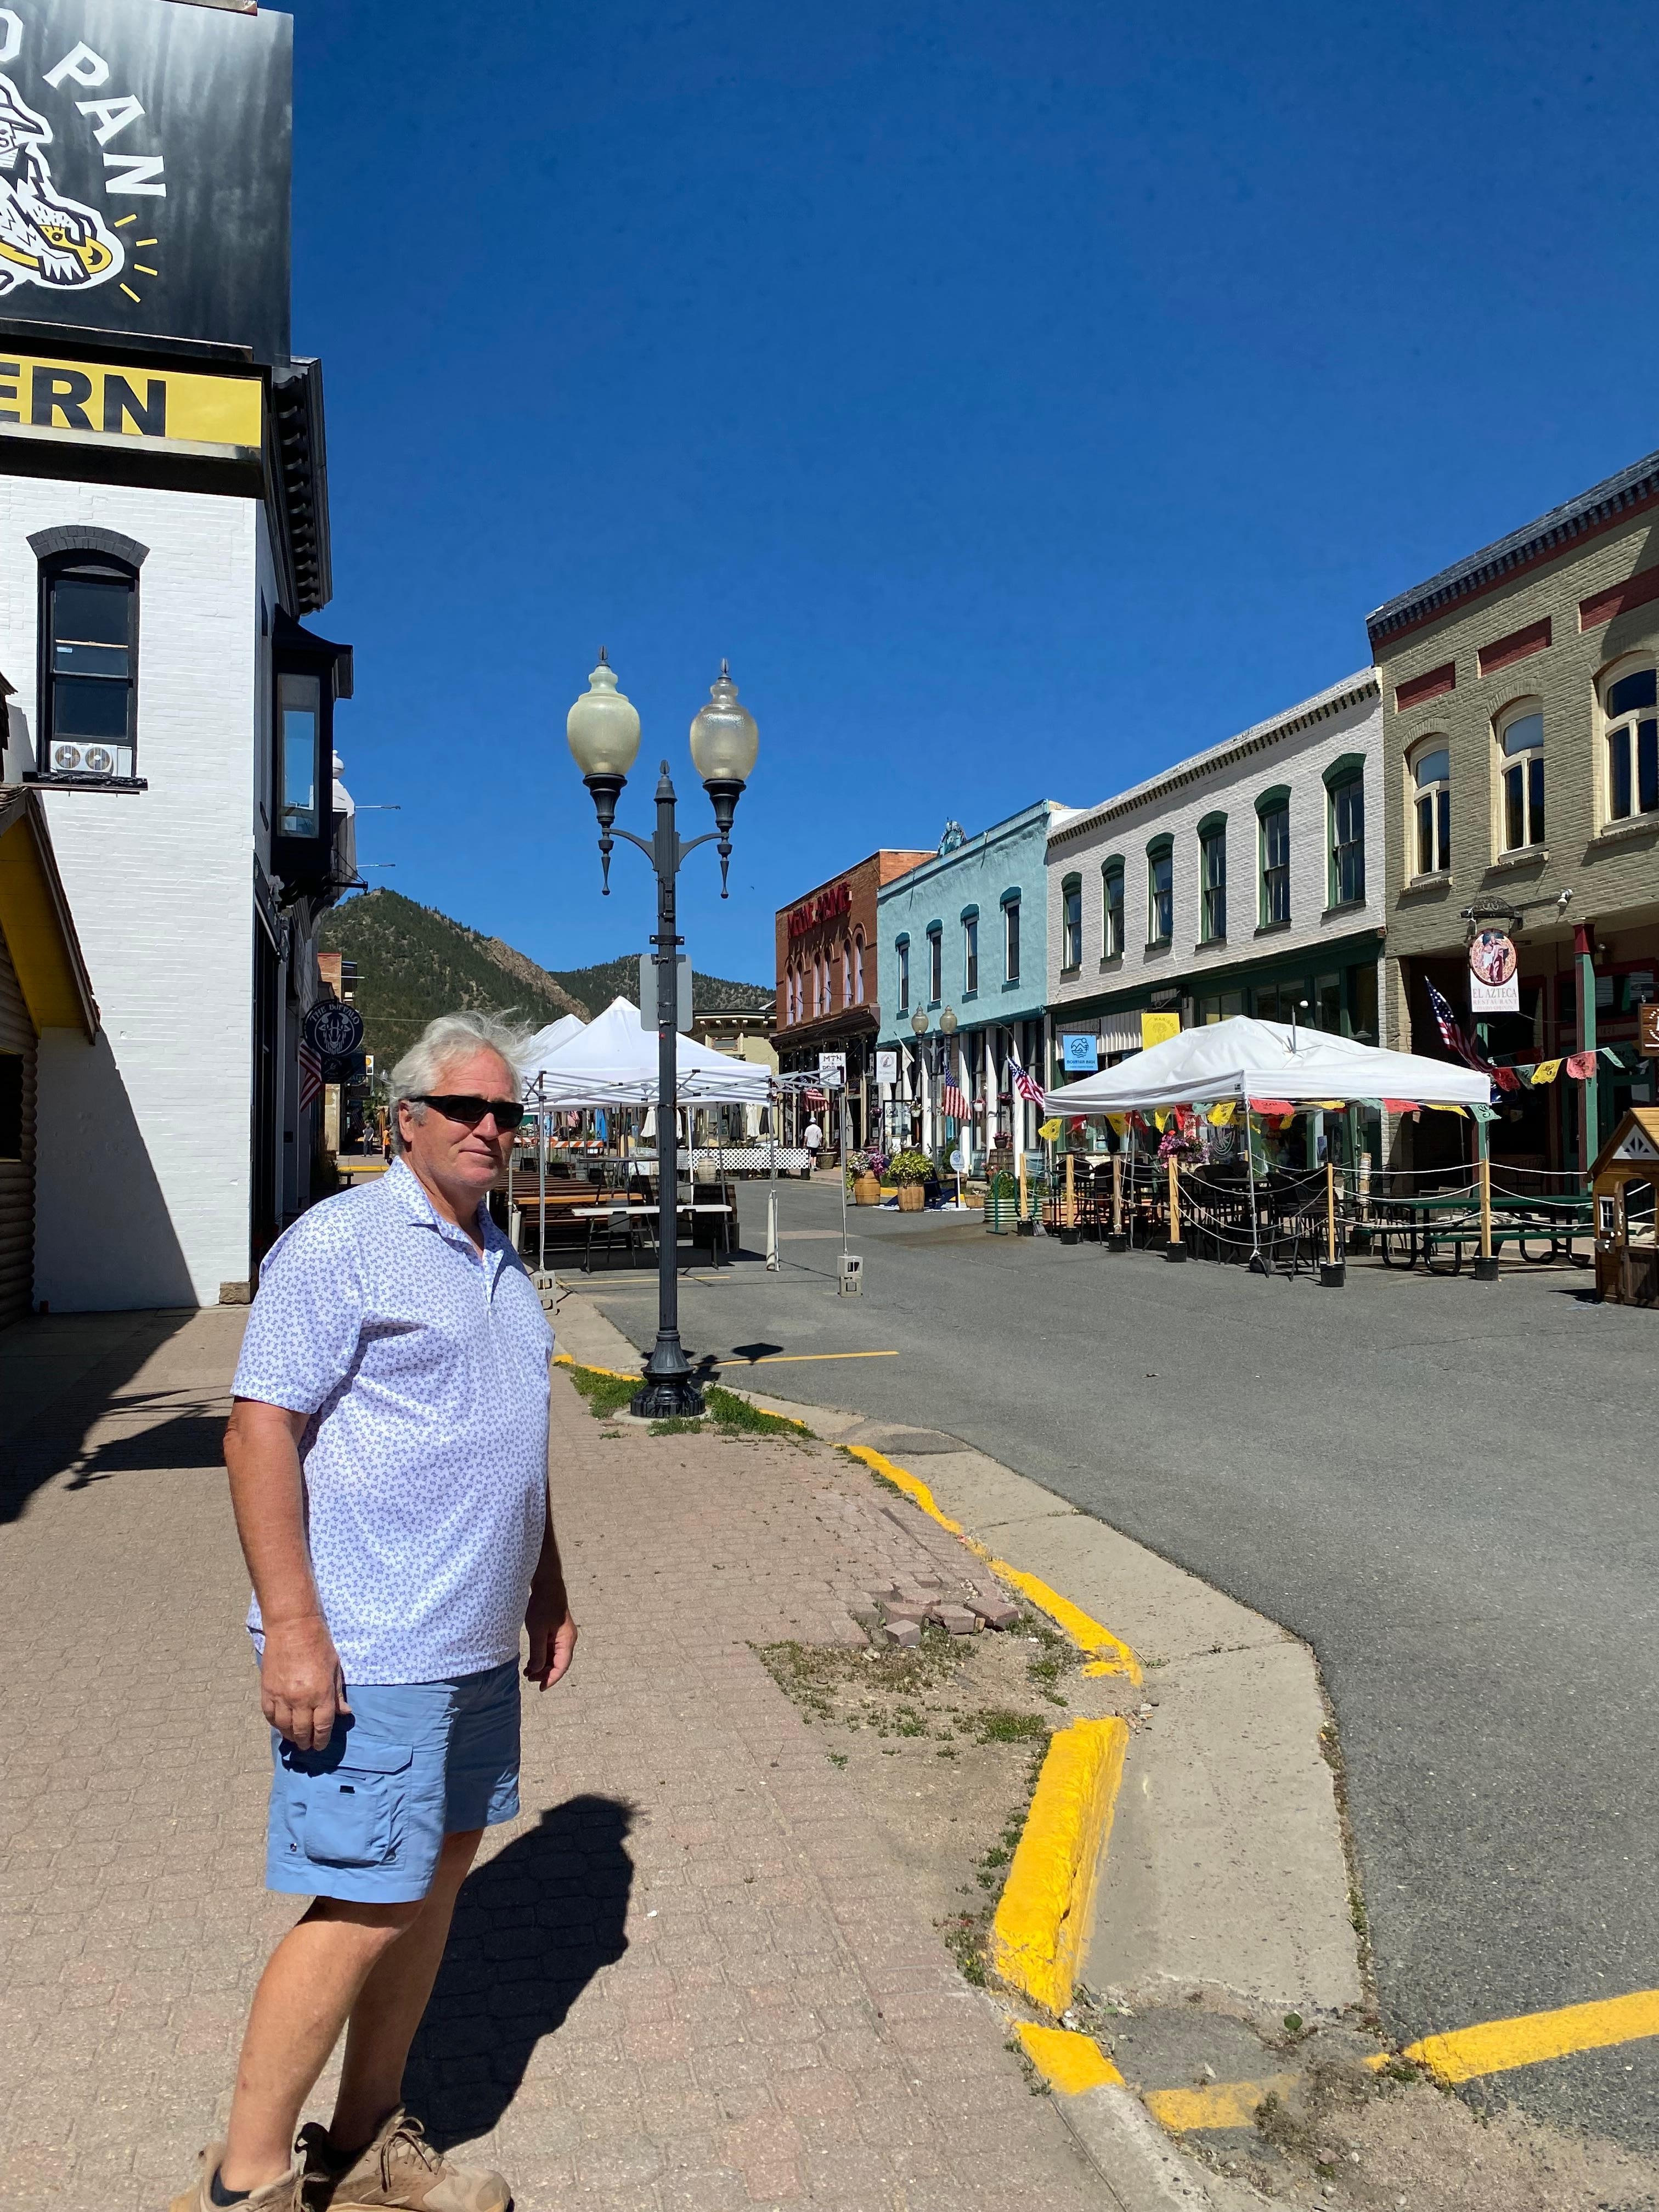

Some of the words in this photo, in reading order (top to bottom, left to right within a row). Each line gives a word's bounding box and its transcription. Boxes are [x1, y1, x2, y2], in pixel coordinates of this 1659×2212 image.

[42, 41, 167, 197] PAN
[1473, 989, 1483, 998] EL
[1486, 988, 1517, 998] AZTECA
[309, 1006, 326, 1022] THE
[329, 1004, 360, 1024] BUFFALO
[1154, 1017, 1177, 1034] MARIGOLD
